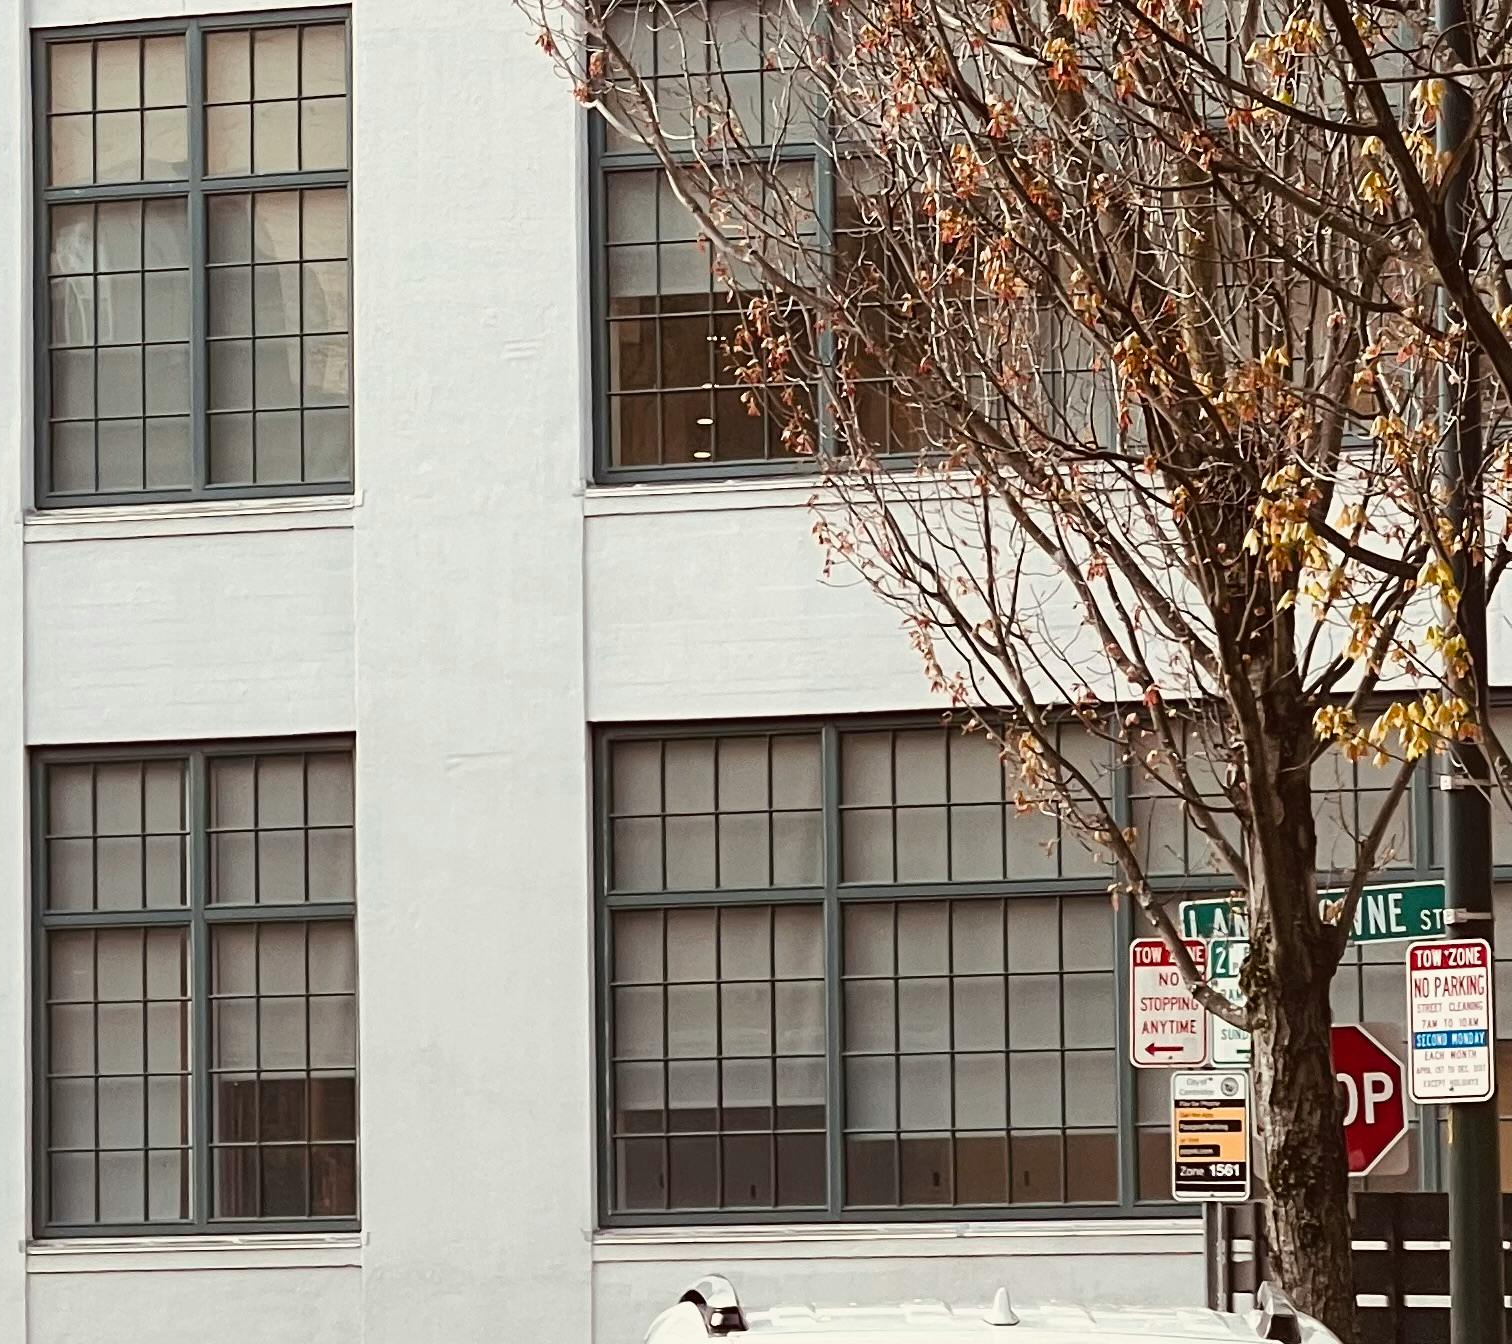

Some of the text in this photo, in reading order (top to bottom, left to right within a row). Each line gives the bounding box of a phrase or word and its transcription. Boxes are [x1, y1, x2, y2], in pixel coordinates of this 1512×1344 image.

[1420, 908, 1443, 931] ST
[1134, 947, 1163, 964] TOW
[1215, 946, 1228, 974] 2
[1414, 946, 1483, 968] TOW ZONE
[1158, 972, 1180, 987] NO
[1414, 974, 1485, 999] NO PARKING
[1140, 996, 1199, 1012] STOPPING
[1142, 1019, 1198, 1035] ANYTIME
[1221, 1029, 1250, 1041] SUND
[1416, 1031, 1485, 1048] SECOND MONDAY
[1424, 1050, 1445, 1061] EACH
[1336, 1072, 1394, 1126] OP
[1180, 1163, 1240, 1177] Zone 1561
